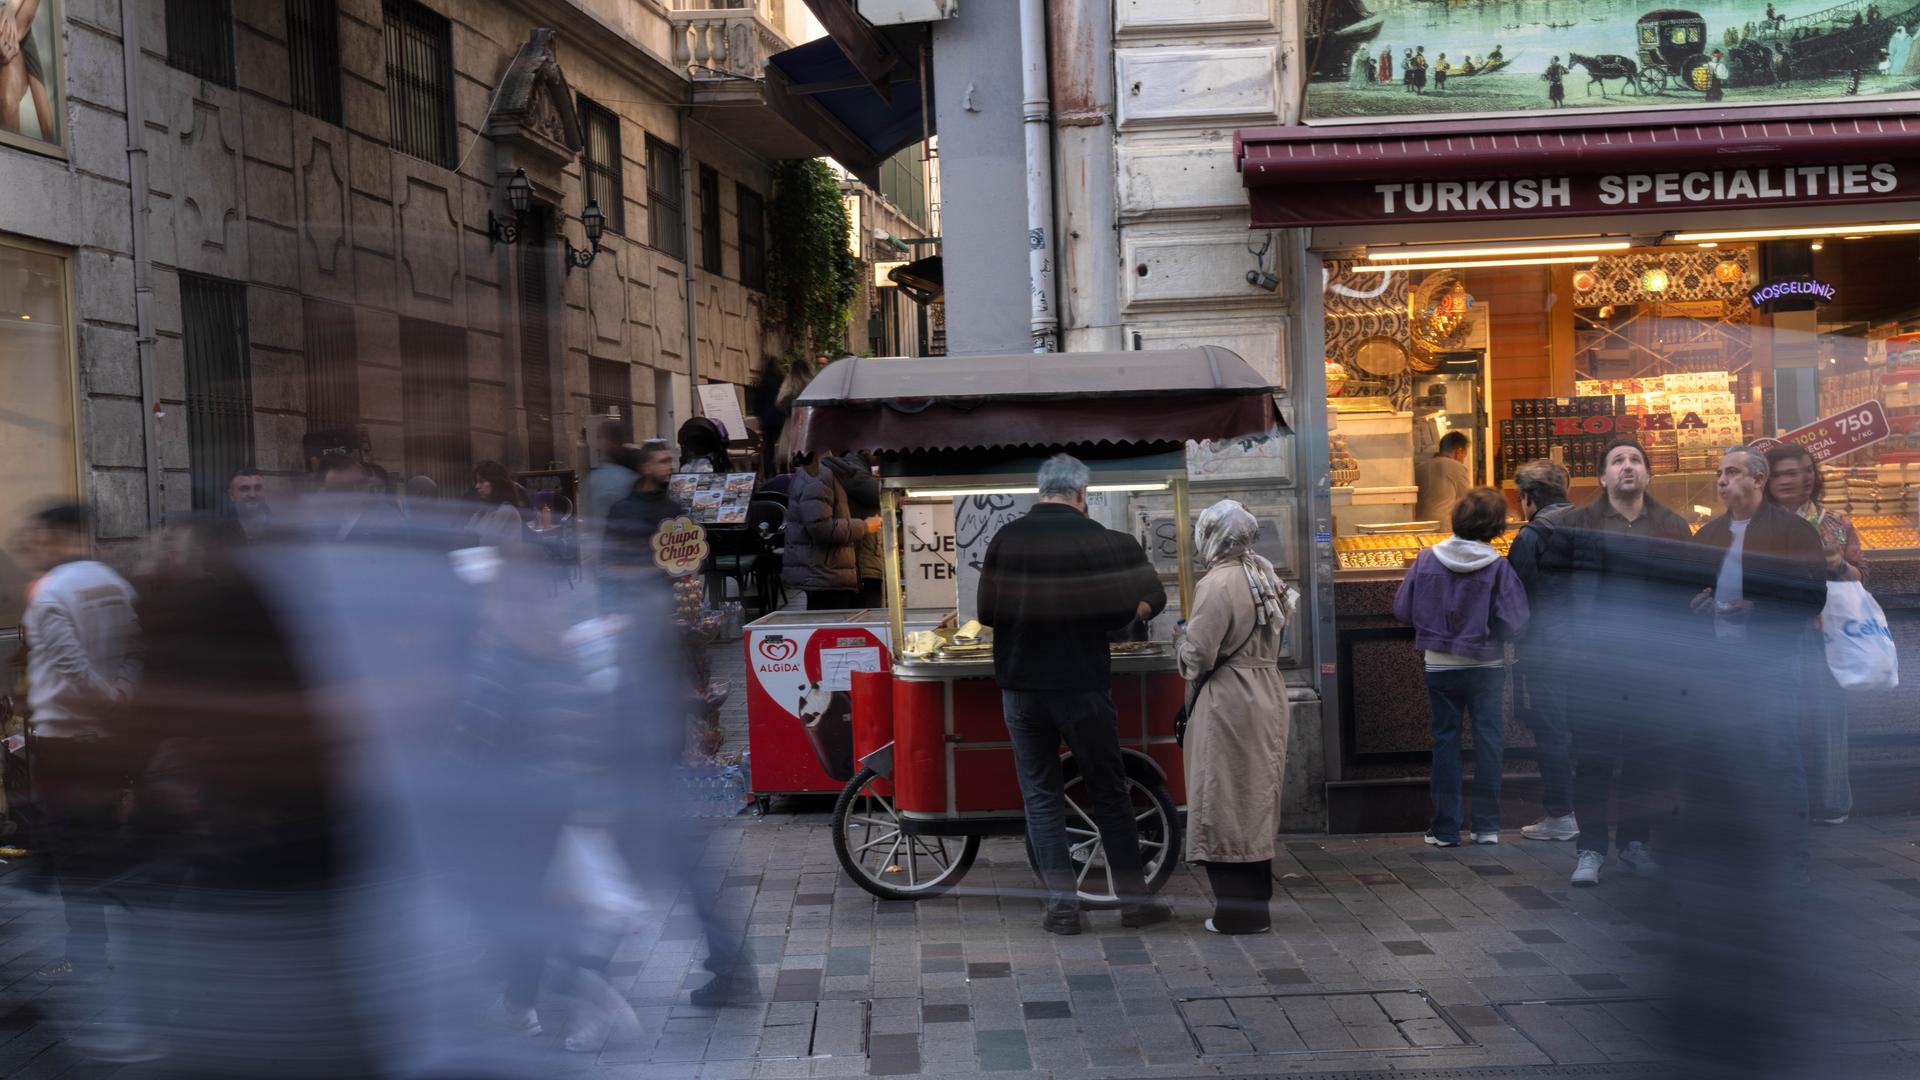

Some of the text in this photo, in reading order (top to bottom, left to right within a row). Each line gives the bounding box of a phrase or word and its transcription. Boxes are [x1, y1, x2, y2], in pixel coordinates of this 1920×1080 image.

[1375, 163, 1898, 213] TURKISH SPECIALITIES
[1751, 280, 1837, 305] HOŞGELDİNİZ
[1552, 412, 1708, 434] KOSKA
[1835, 410, 1873, 435] 750
[660, 530, 699, 547] Chupa
[661, 543, 700, 567] Chups
